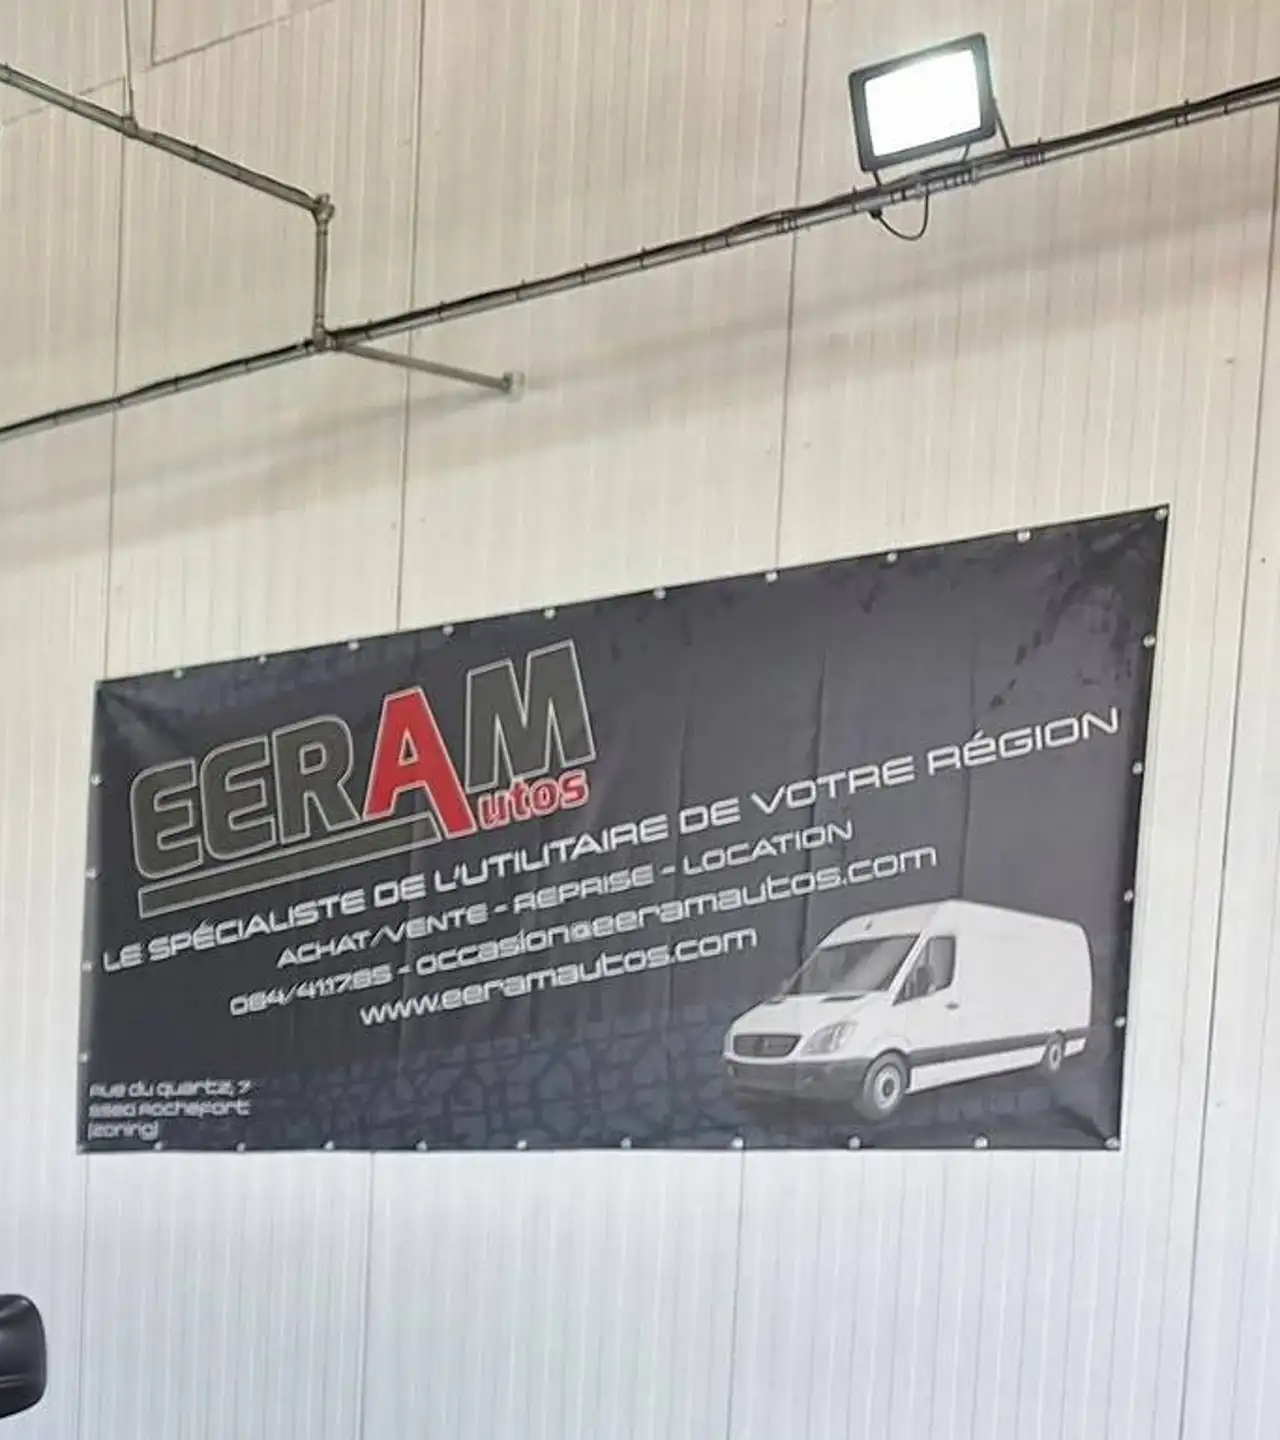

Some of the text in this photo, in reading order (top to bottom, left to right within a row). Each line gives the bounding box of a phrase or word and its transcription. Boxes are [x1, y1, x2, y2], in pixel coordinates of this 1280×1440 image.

[131, 638, 597, 879] EERAM
[102, 707, 1121, 973] LE SPÉCIALISTE DE L'UTILITAIRE DE VOTRE RÉGION
[276, 903, 490, 970] ACHAT/VENTE
[513, 863, 655, 914] REPRISE
[682, 820, 854, 877] LOCATION
[416, 845, 938, 975] occasion@eeramautos.com
[359, 925, 759, 1027] www.eeramautos.com
